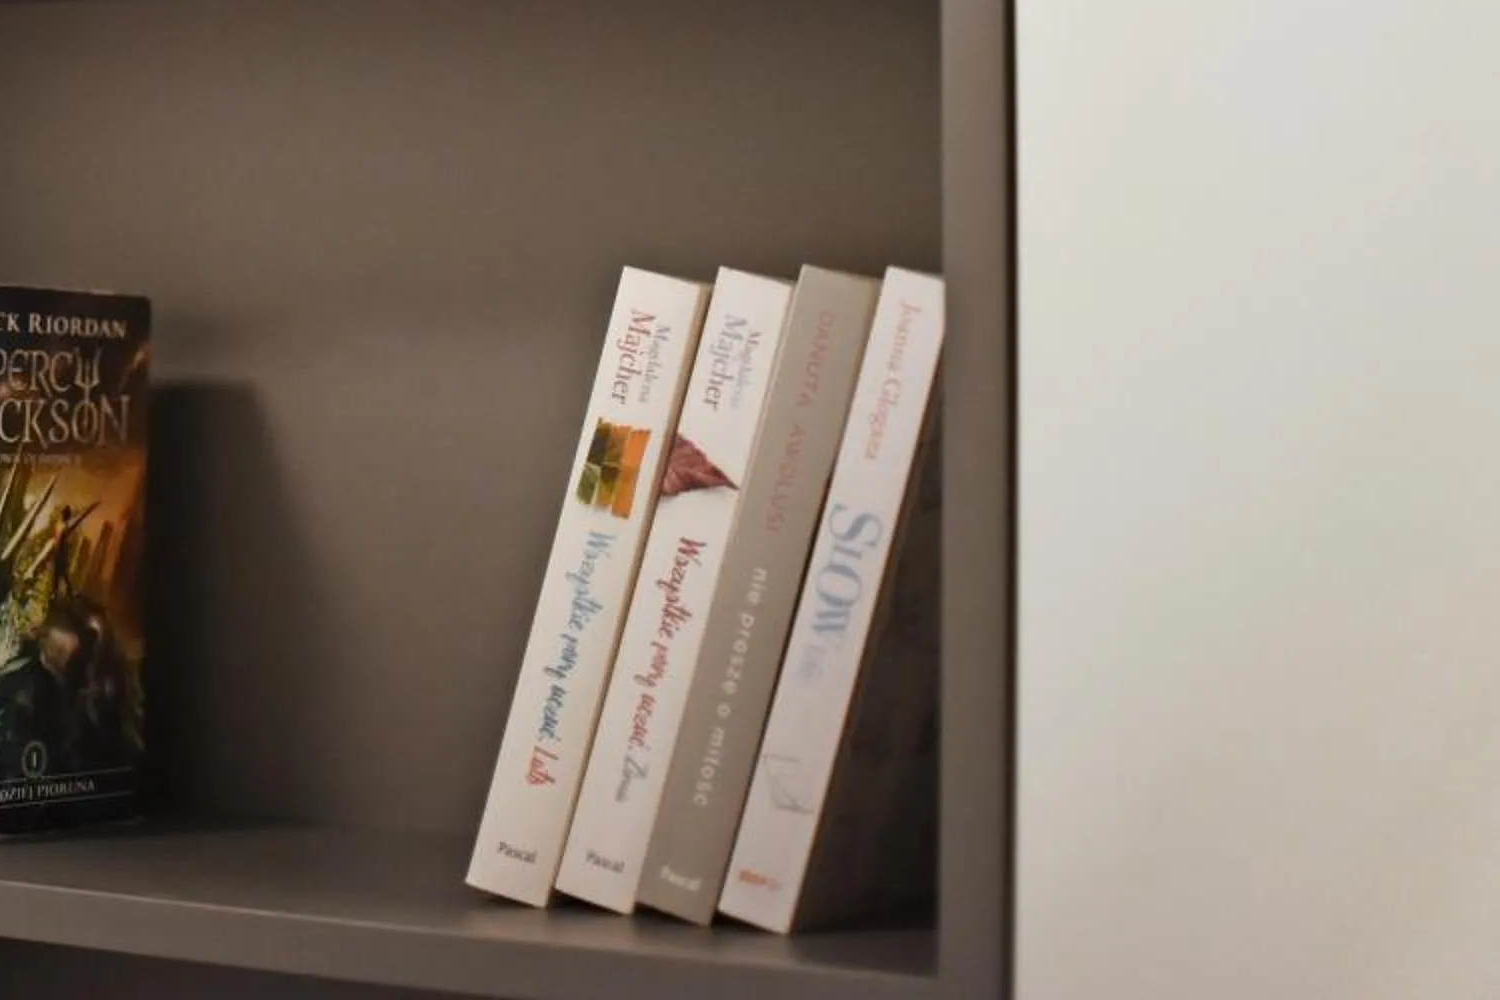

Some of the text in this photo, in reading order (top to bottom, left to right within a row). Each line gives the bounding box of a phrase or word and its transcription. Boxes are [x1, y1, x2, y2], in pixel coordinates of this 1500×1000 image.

[27, 311, 129, 340] RIORDAN
[611, 308, 657, 405] Majcher
[702, 313, 749, 412] Majcher
[796, 310, 837, 407] DANUTA
[745, 566, 768, 606] nie
[716, 703, 731, 720] o
[497, 840, 538, 865] Pascal
